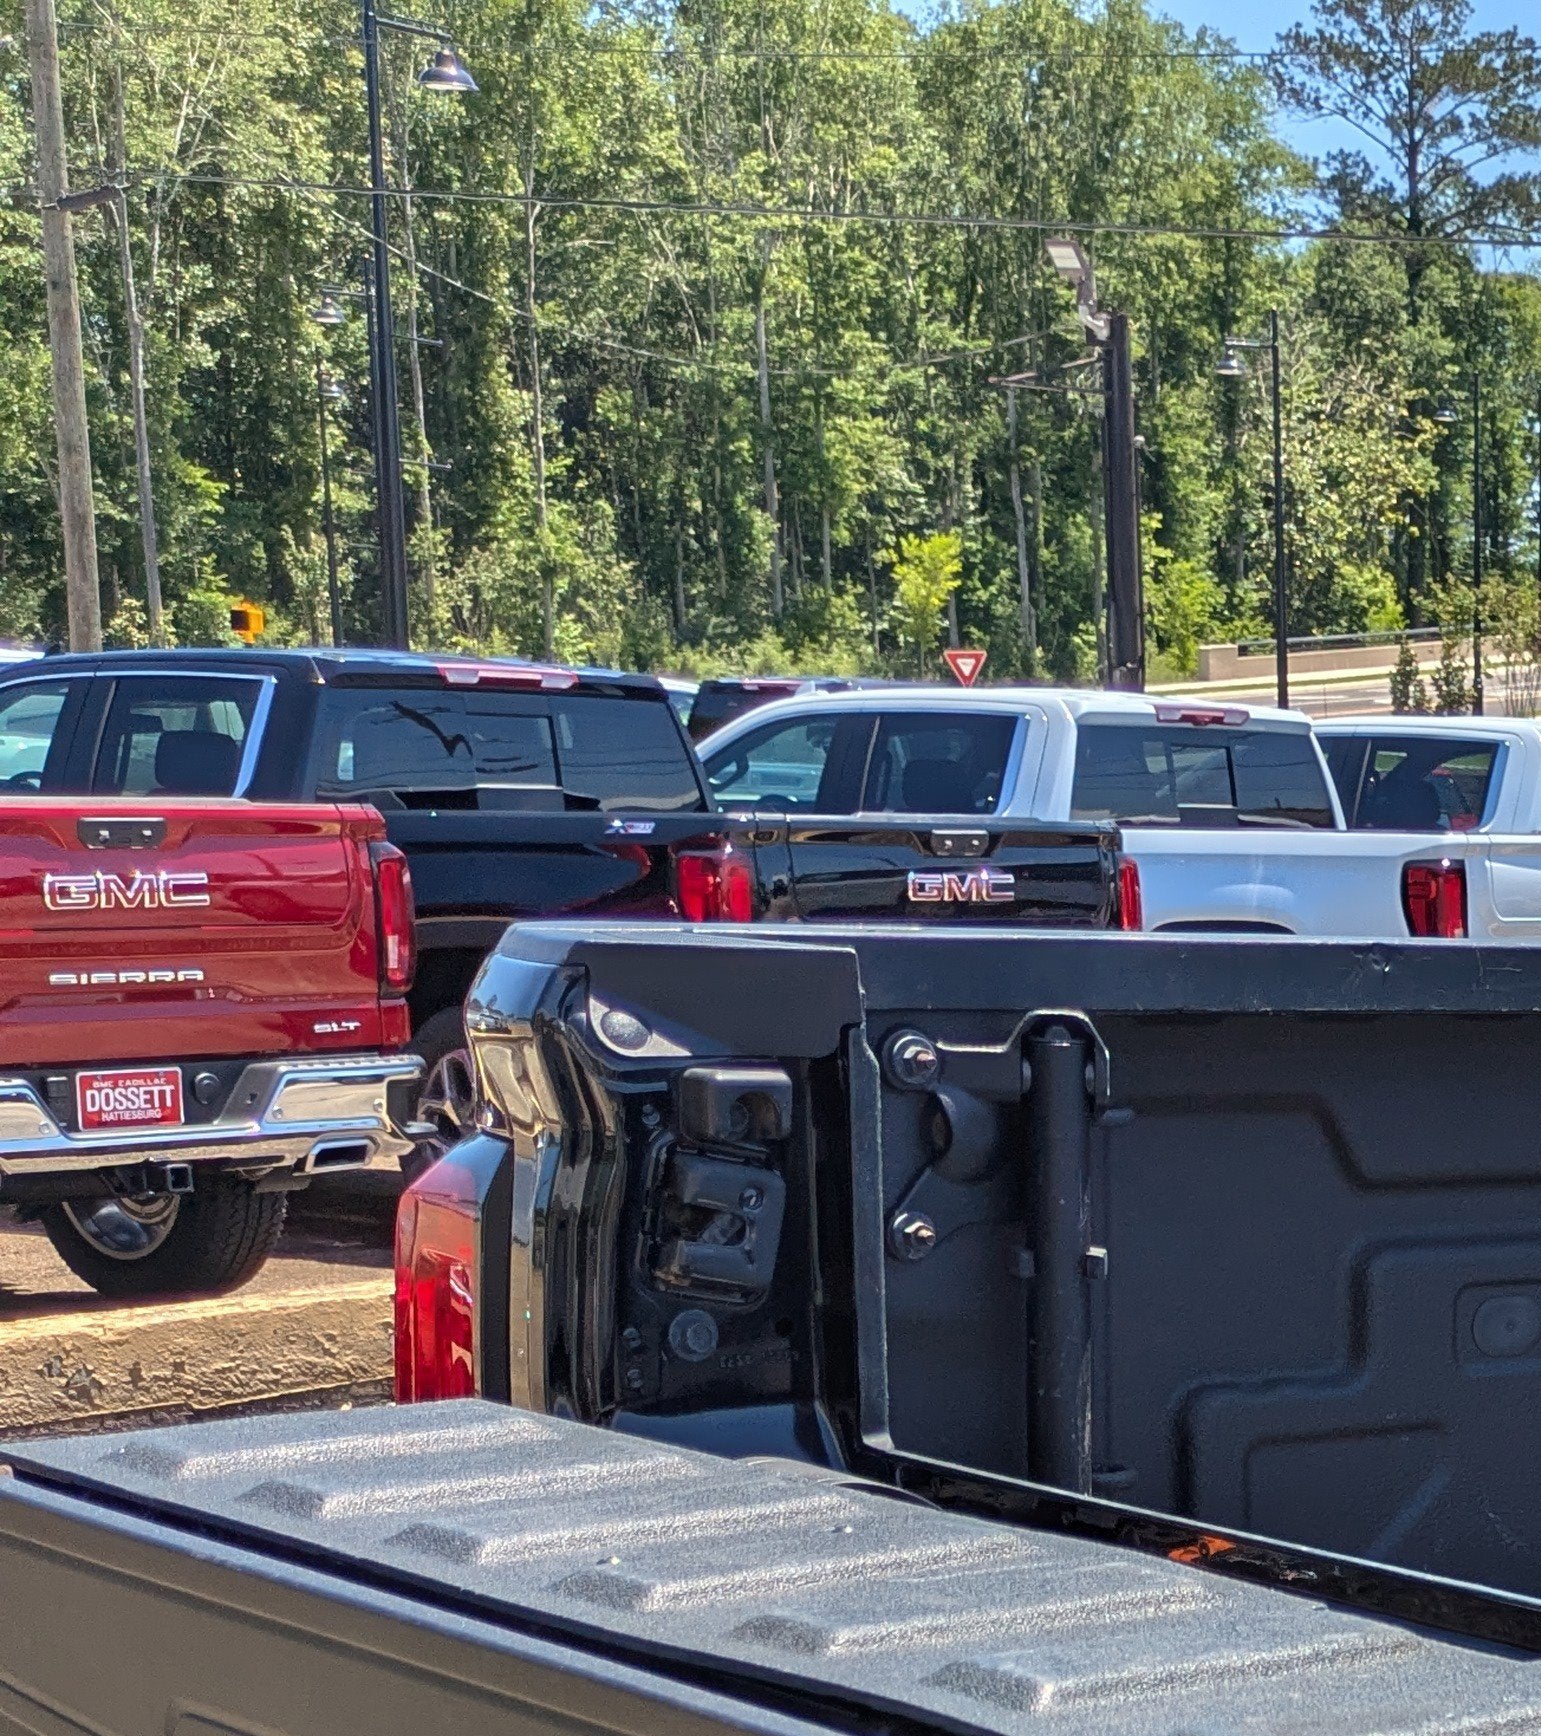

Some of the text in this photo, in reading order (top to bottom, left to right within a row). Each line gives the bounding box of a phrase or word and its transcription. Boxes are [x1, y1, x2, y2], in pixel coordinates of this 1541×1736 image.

[44, 871, 210, 910] GMC
[908, 869, 1015, 901] GMC
[49, 970, 204, 985] SIERRA
[314, 1021, 361, 1033] SLT
[118, 1078, 167, 1086] CADILLAC
[86, 1085, 175, 1112] DOSSETT
[101, 1109, 162, 1121] HATTIESBURG
